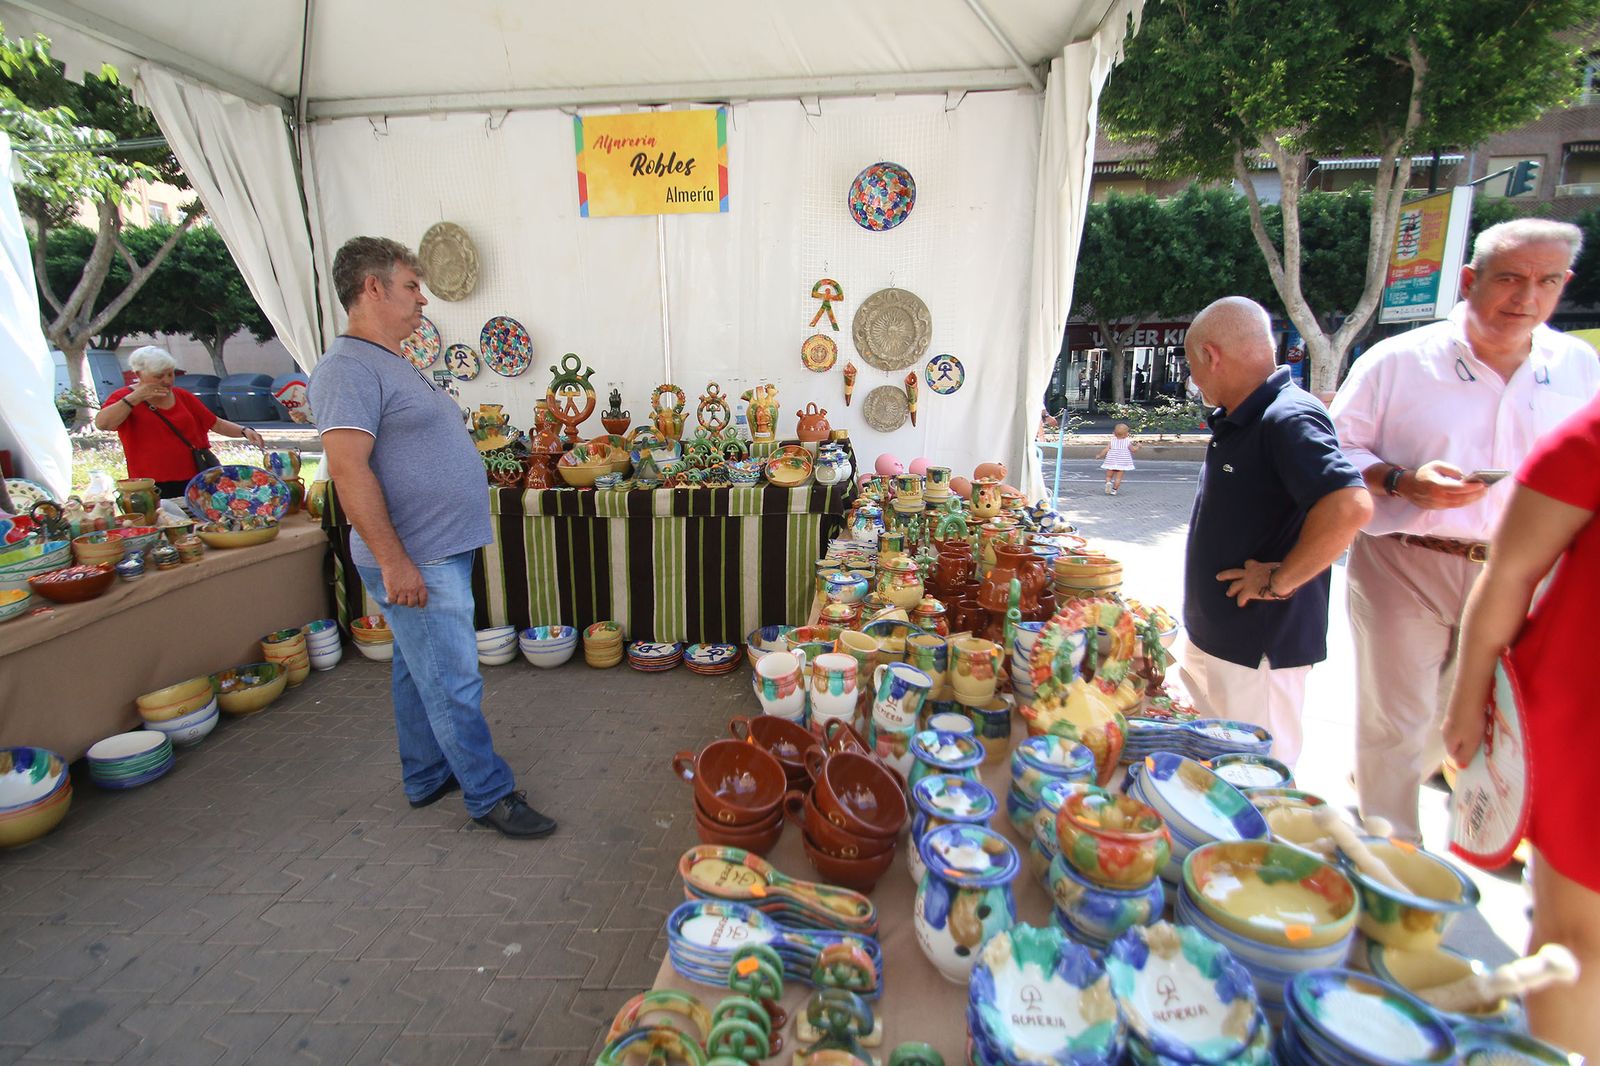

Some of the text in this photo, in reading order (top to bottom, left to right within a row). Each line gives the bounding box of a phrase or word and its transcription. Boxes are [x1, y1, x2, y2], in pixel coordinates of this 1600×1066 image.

[630, 151, 696, 178] Robles
[665, 185, 714, 203] Almería
[1163, 327, 1188, 345] KI
